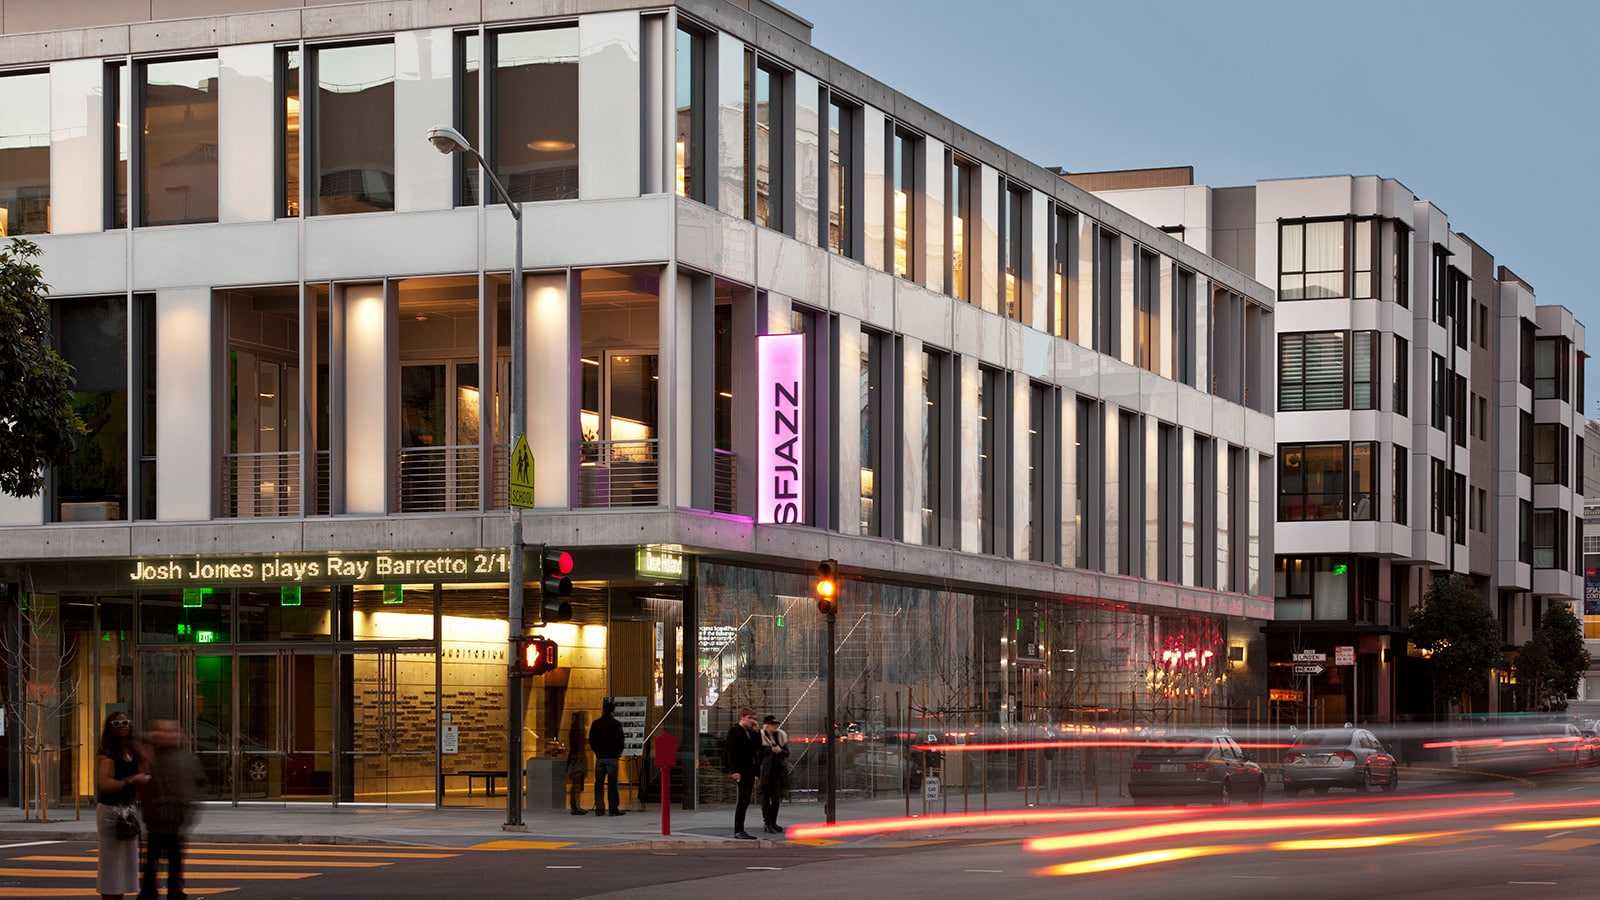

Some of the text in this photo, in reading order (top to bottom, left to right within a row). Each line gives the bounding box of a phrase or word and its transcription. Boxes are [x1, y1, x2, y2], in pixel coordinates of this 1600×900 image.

[774, 381, 798, 525] SFJAZZ
[130, 553, 512, 582] Josh Jones plays Ray Barretto 2/1
